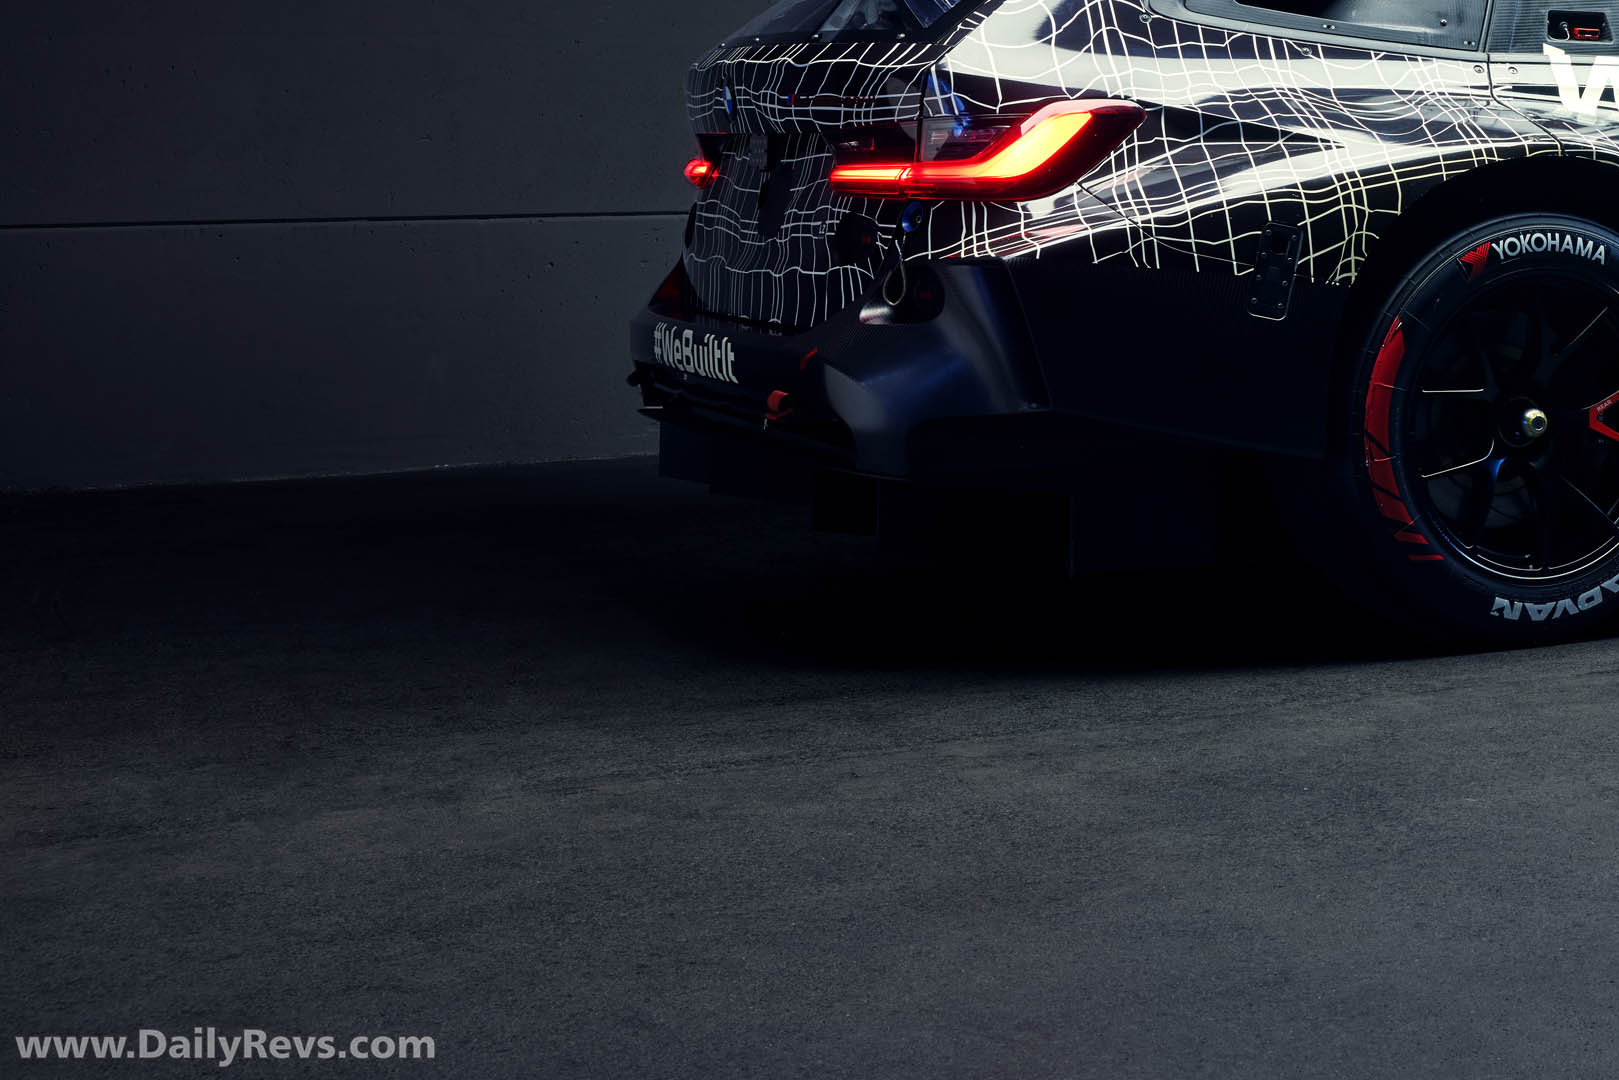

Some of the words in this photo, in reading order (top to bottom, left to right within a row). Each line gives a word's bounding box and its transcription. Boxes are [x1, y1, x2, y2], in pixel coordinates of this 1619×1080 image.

[1491, 231, 1608, 266] YOKOHAMA
[654, 321, 739, 384] #WeBuiltIt
[1596, 399, 1612, 412] REAR
